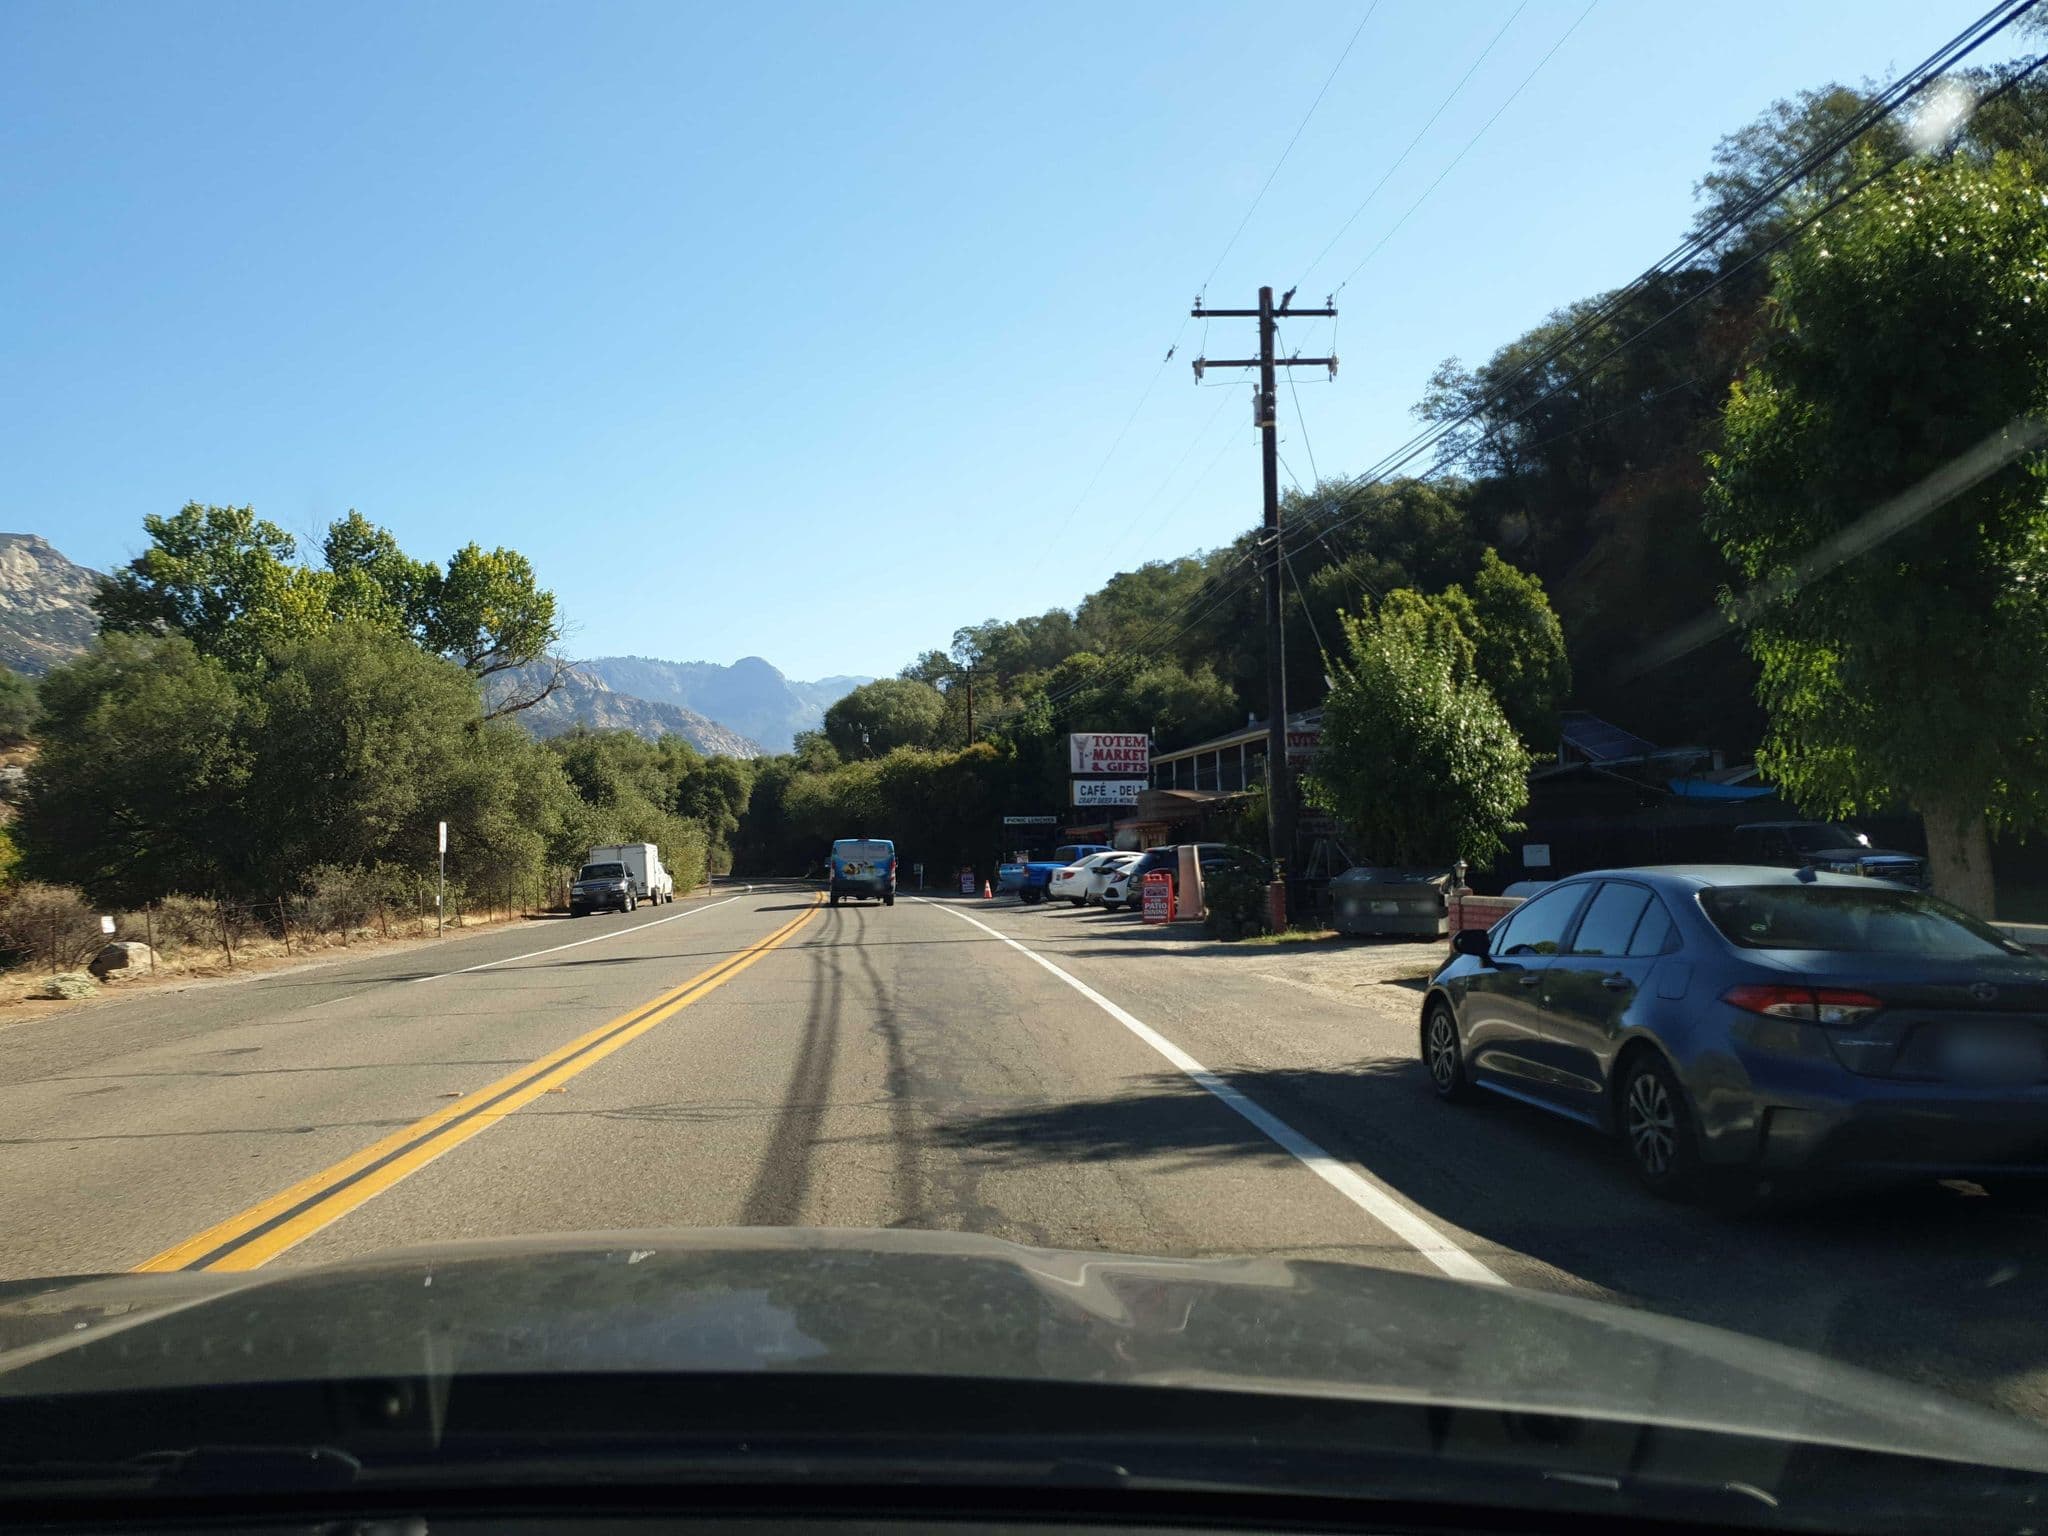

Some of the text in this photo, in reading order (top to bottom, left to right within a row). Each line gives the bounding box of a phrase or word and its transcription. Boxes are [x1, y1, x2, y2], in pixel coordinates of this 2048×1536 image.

[1092, 735, 1146, 747] TOTEM
[1092, 749, 1147, 761] MARKET
[1092, 762, 1147, 771] & GIFTS
[1080, 782, 1106, 795] CAFÉ
